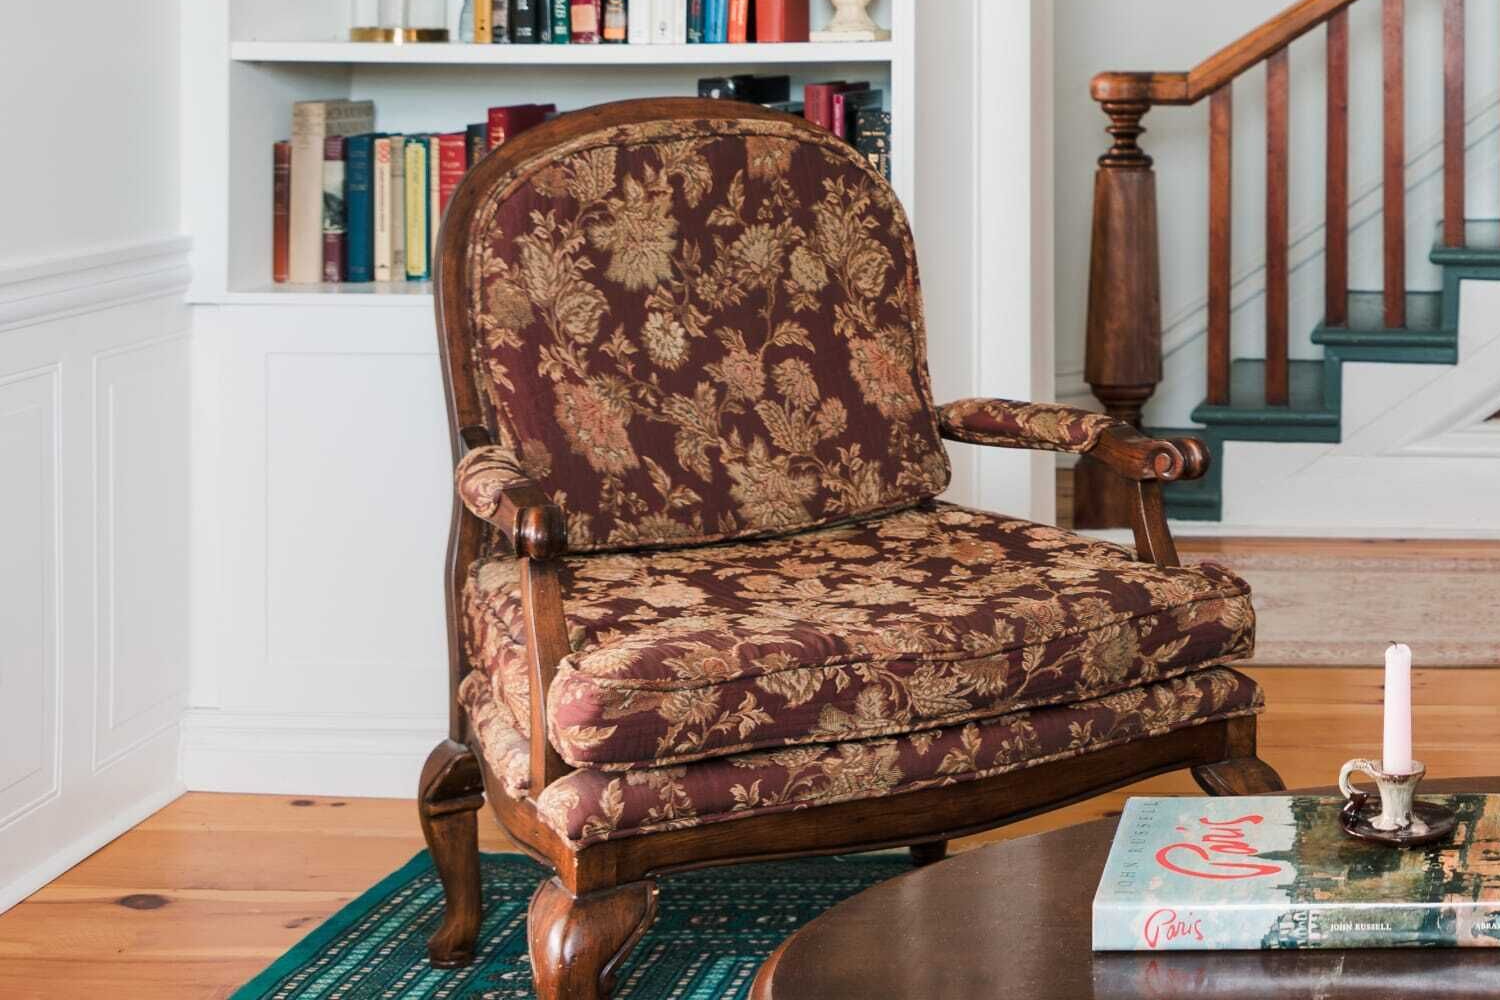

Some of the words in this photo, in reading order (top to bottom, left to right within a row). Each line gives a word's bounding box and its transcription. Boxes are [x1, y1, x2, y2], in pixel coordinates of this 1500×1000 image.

[1155, 815, 1283, 880] Paris
[1144, 908, 1204, 949] Paris
[1330, 922, 1353, 931] JOHN
[1355, 922, 1392, 931] RUSSELL
